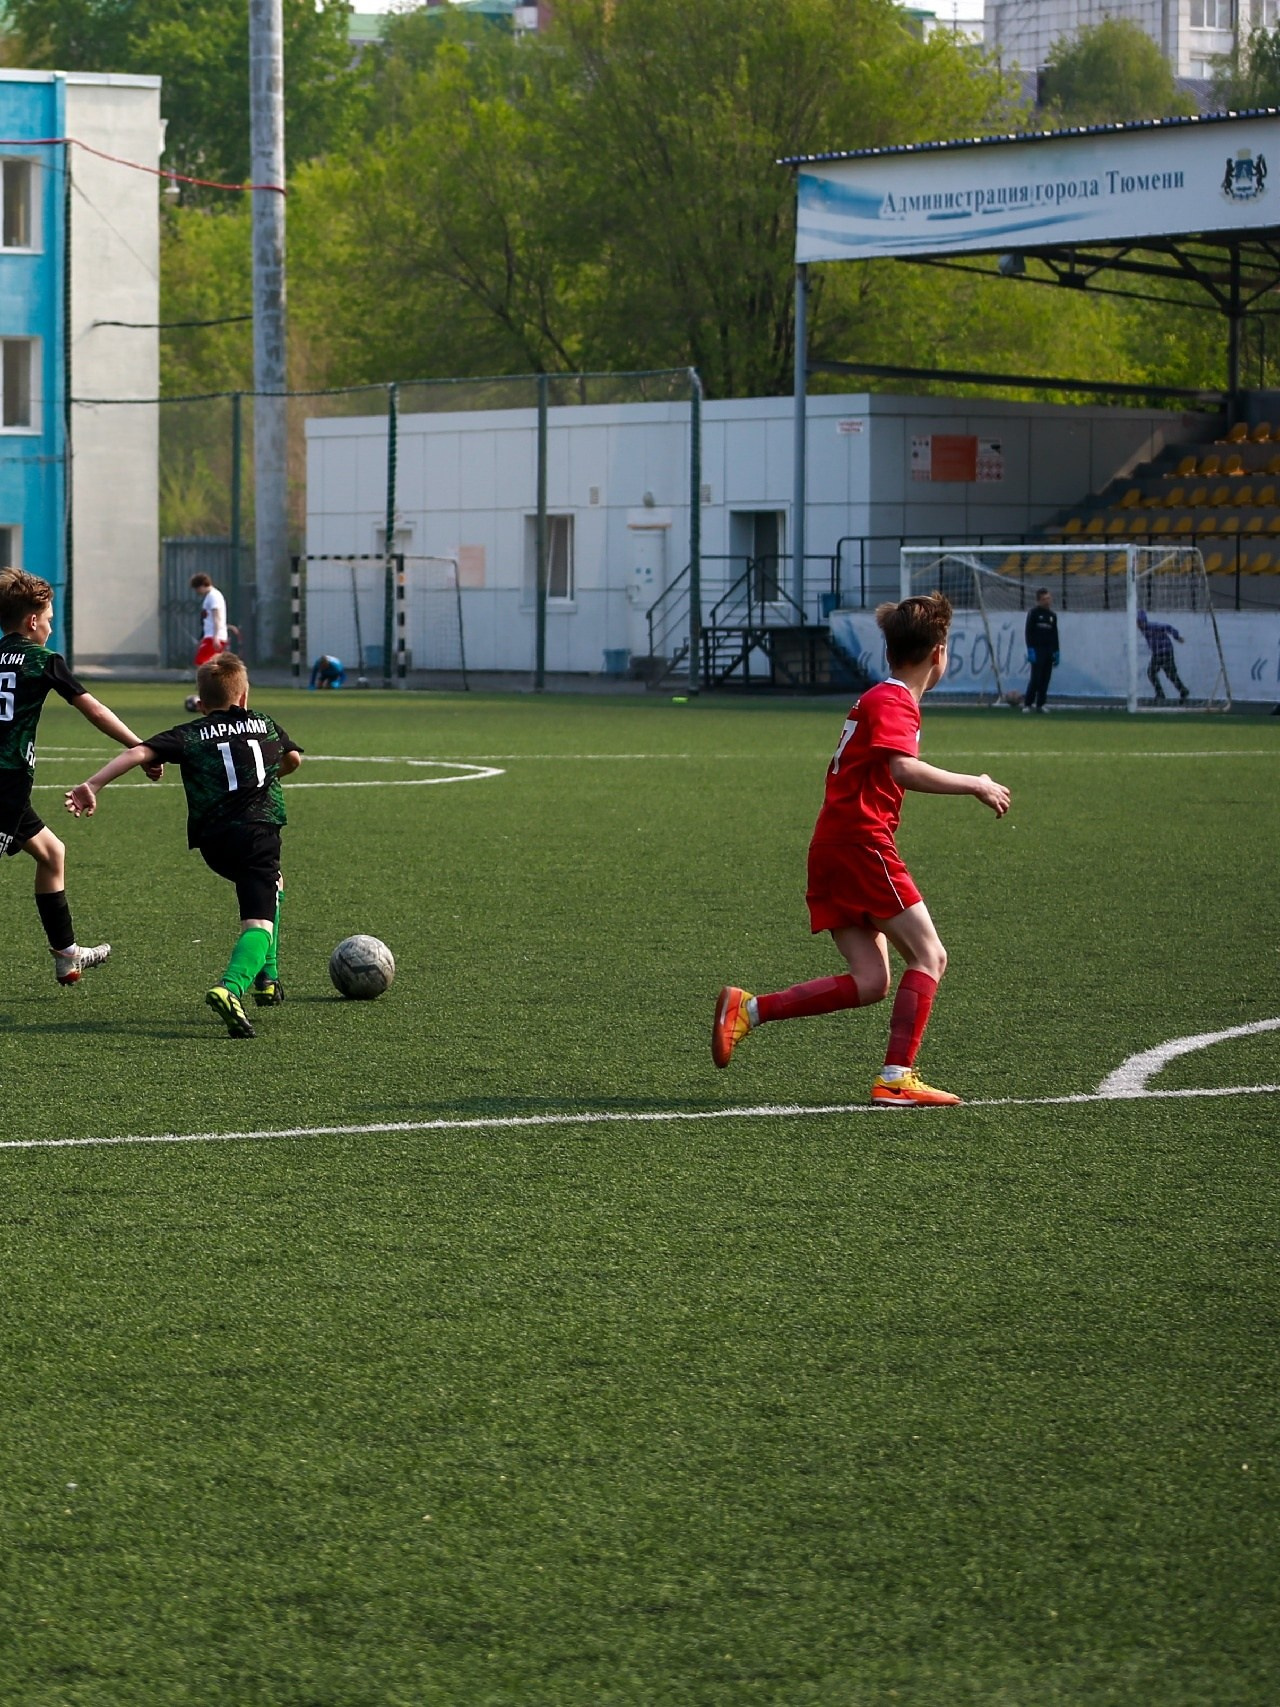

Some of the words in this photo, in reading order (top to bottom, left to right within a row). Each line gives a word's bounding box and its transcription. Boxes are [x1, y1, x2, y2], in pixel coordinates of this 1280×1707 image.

[883, 184, 1029, 214] Администрация
[1035, 179, 1099, 205] города
[1105, 170, 1185, 195] Тюмени
[200, 717, 268, 740] НАРАЙКИН
[216, 739, 266, 791] 11
